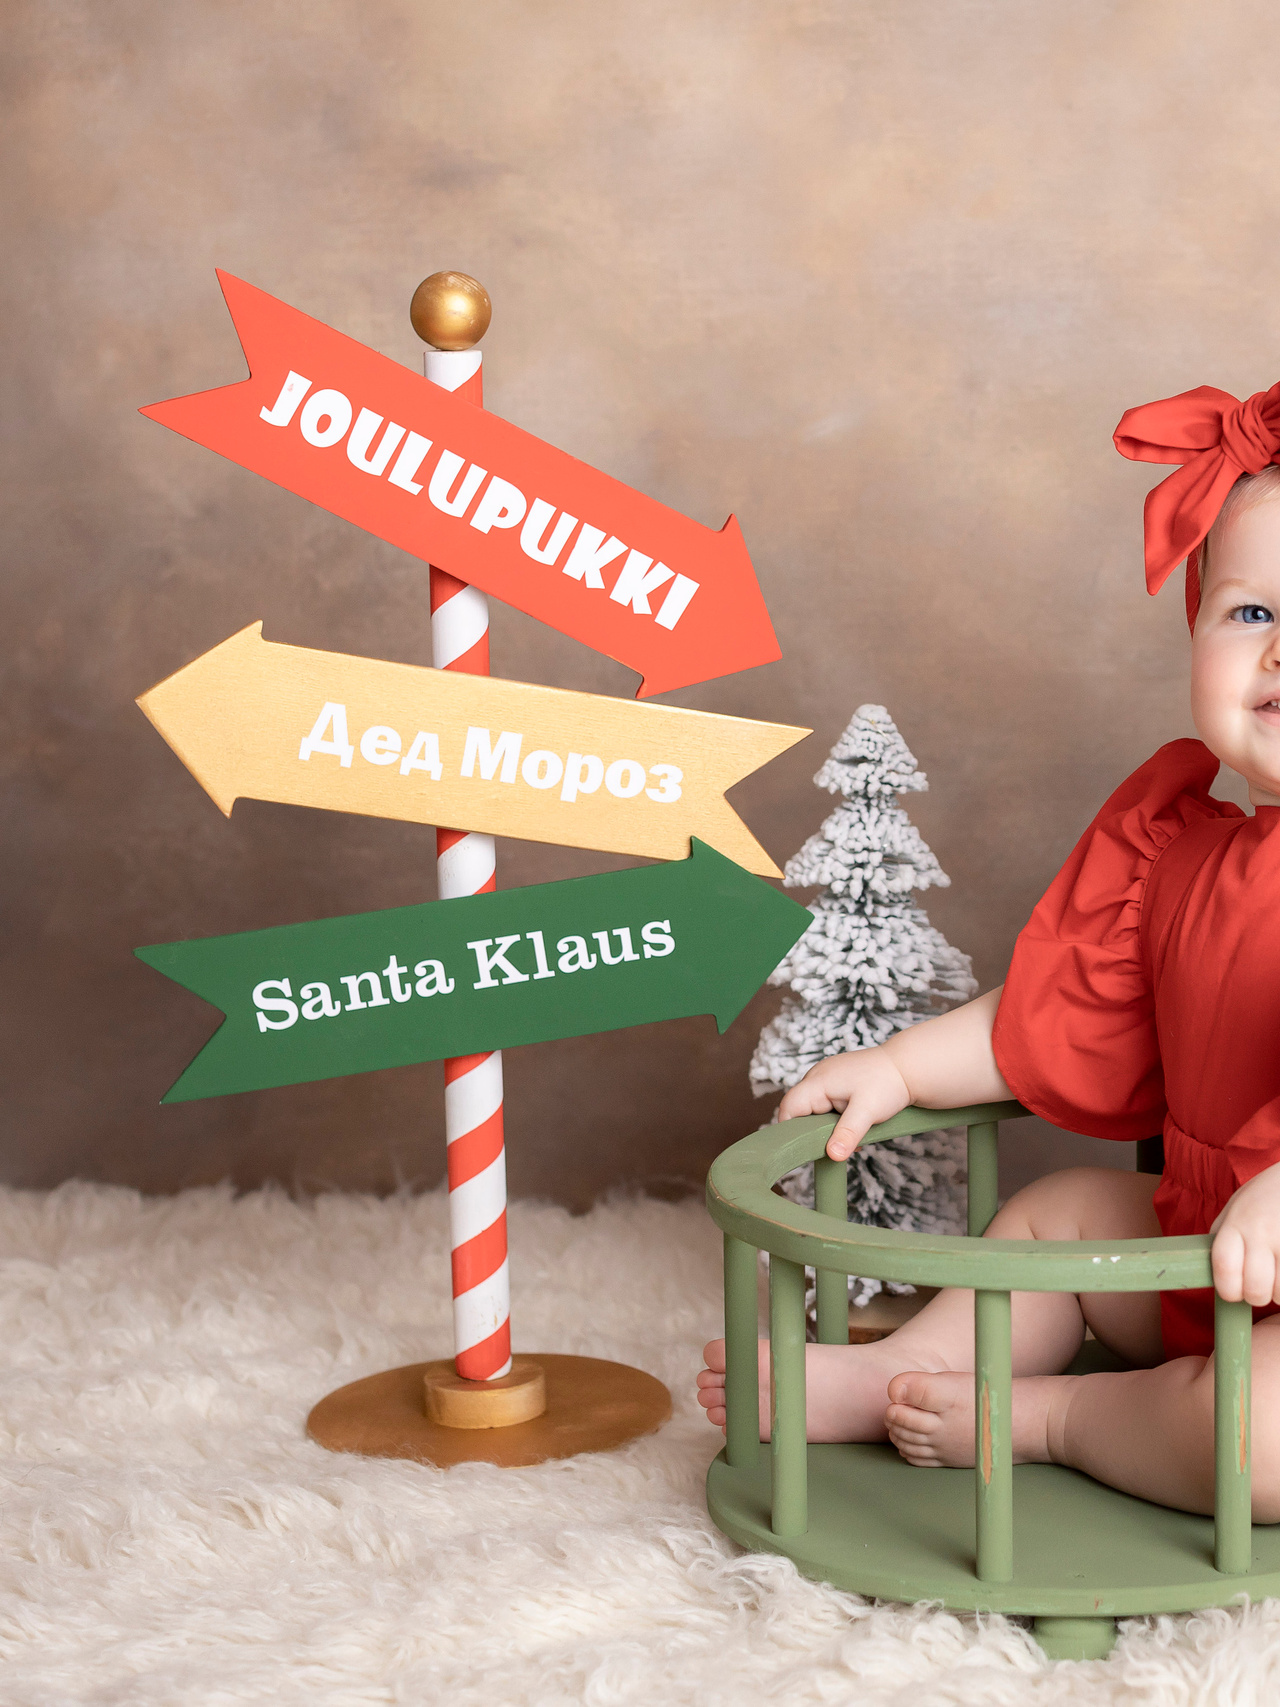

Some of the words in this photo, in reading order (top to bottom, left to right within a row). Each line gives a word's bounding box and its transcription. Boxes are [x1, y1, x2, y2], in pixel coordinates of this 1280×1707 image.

[259, 370, 700, 631] JOULUPUKKI
[298, 701, 443, 778] Дед
[461, 726, 684, 804] Мороз
[251, 952, 455, 1033] Santa
[466, 919, 676, 990] Klaus
